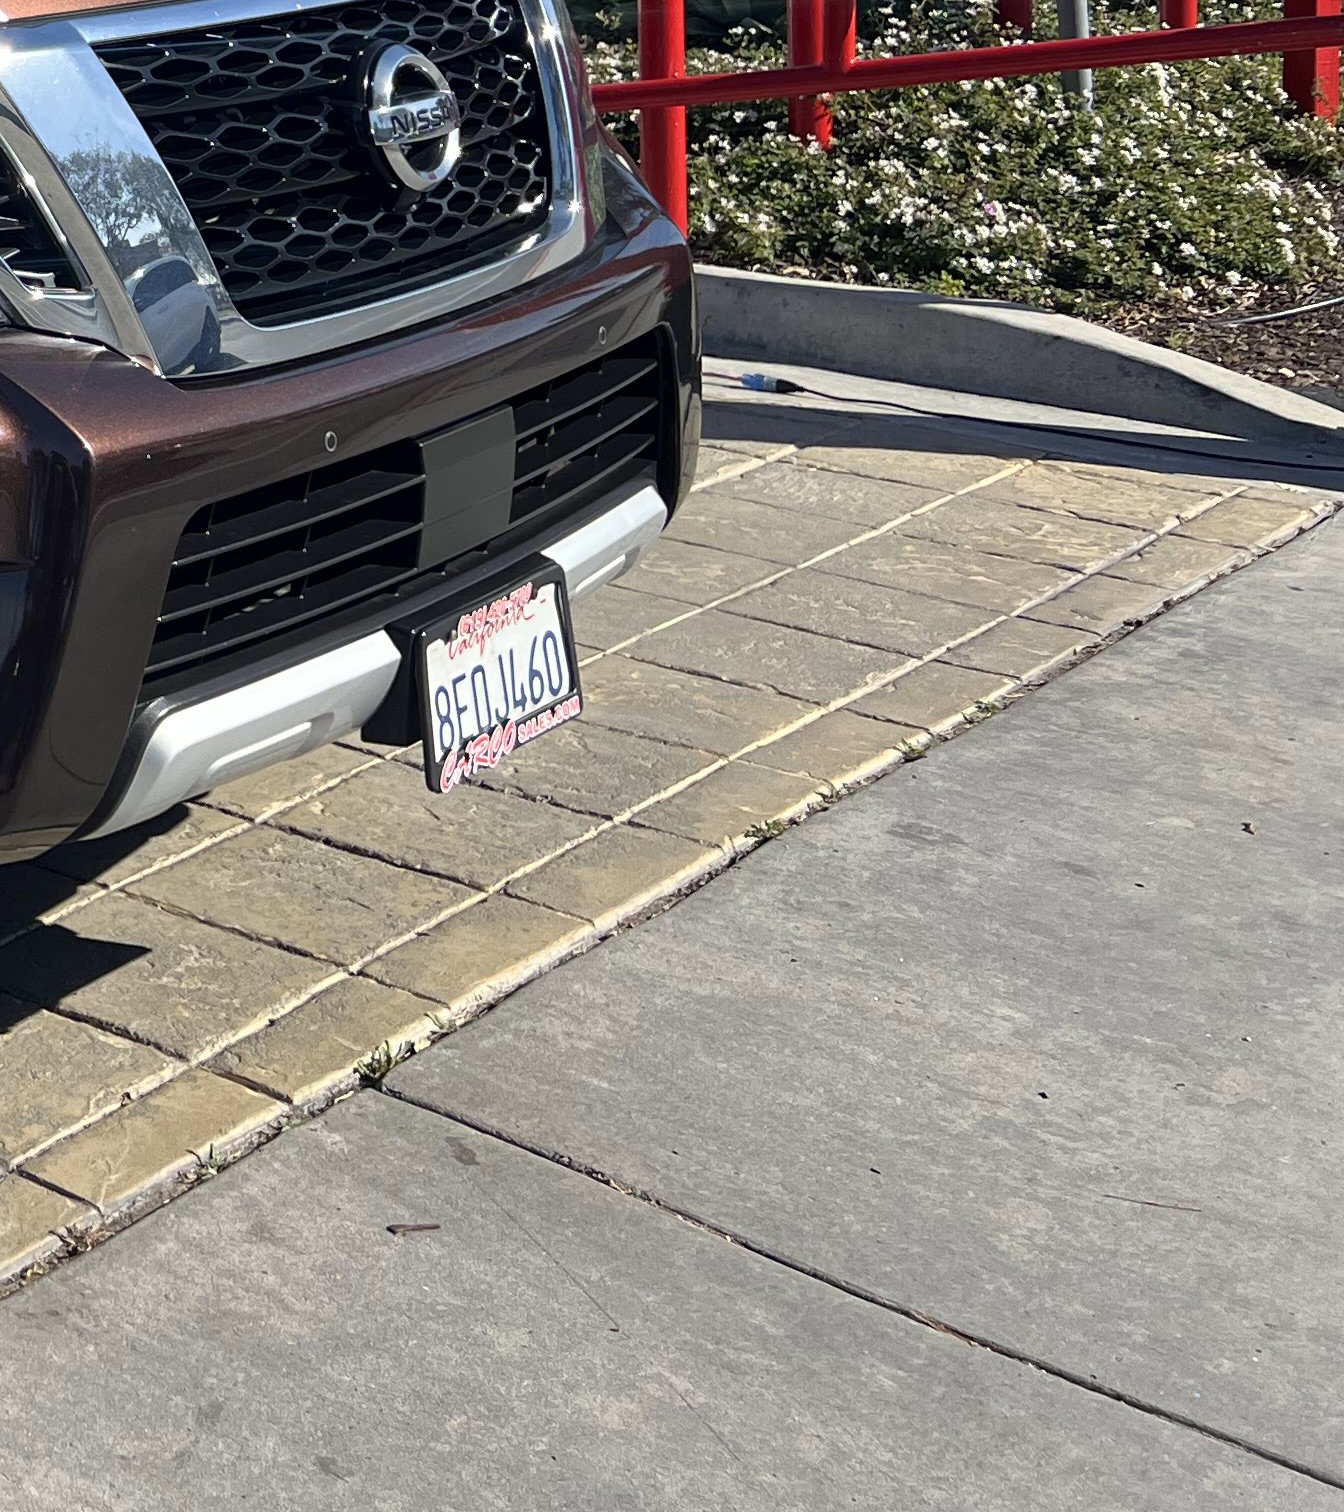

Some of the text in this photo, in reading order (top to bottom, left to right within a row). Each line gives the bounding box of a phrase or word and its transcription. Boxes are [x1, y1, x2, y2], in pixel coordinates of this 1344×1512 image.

[390, 93, 461, 136] NISSAN
[440, 695, 580, 793] CARCO SALES.COM
